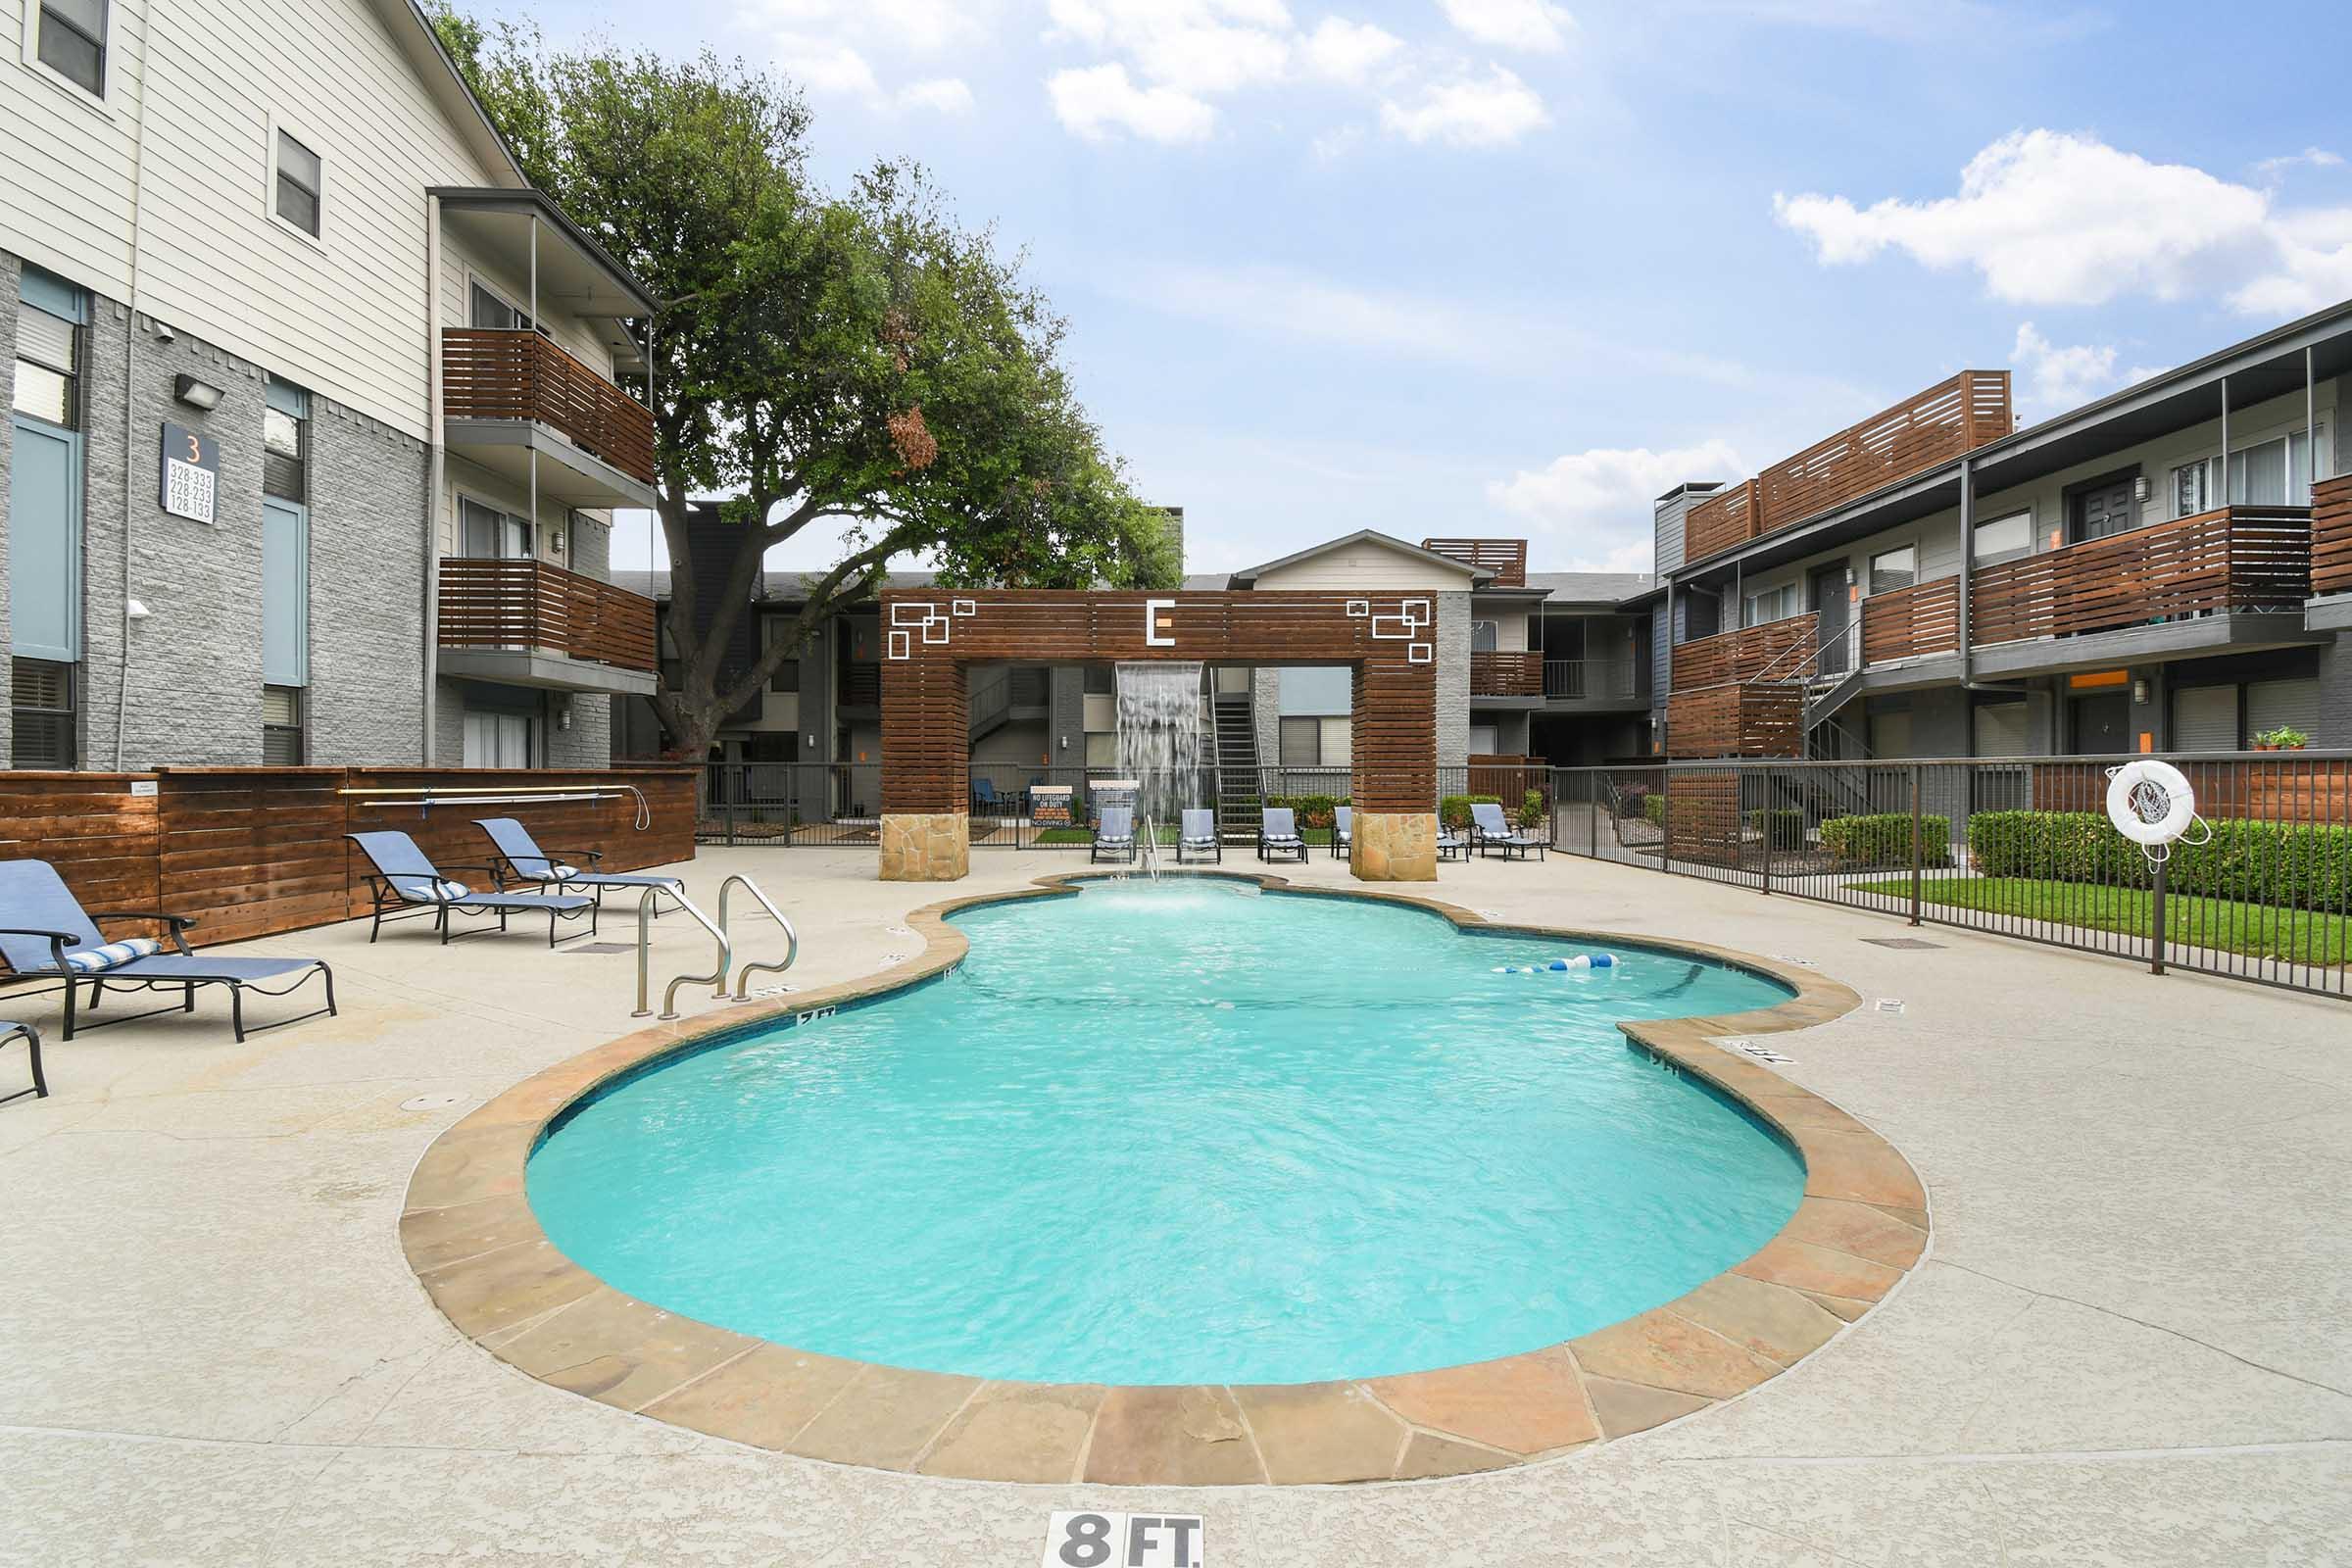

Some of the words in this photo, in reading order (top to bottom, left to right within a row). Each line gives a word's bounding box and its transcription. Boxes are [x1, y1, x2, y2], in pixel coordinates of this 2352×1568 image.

[186, 435, 201, 463] 3
[171, 464, 212, 489] 328-333
[171, 478, 212, 504] 228-233
[171, 494, 211, 517] 128-133
[801, 1011, 813, 1025] 7
[1059, 1514, 1111, 1568] 8
[1128, 1517, 1200, 1568] FT.
